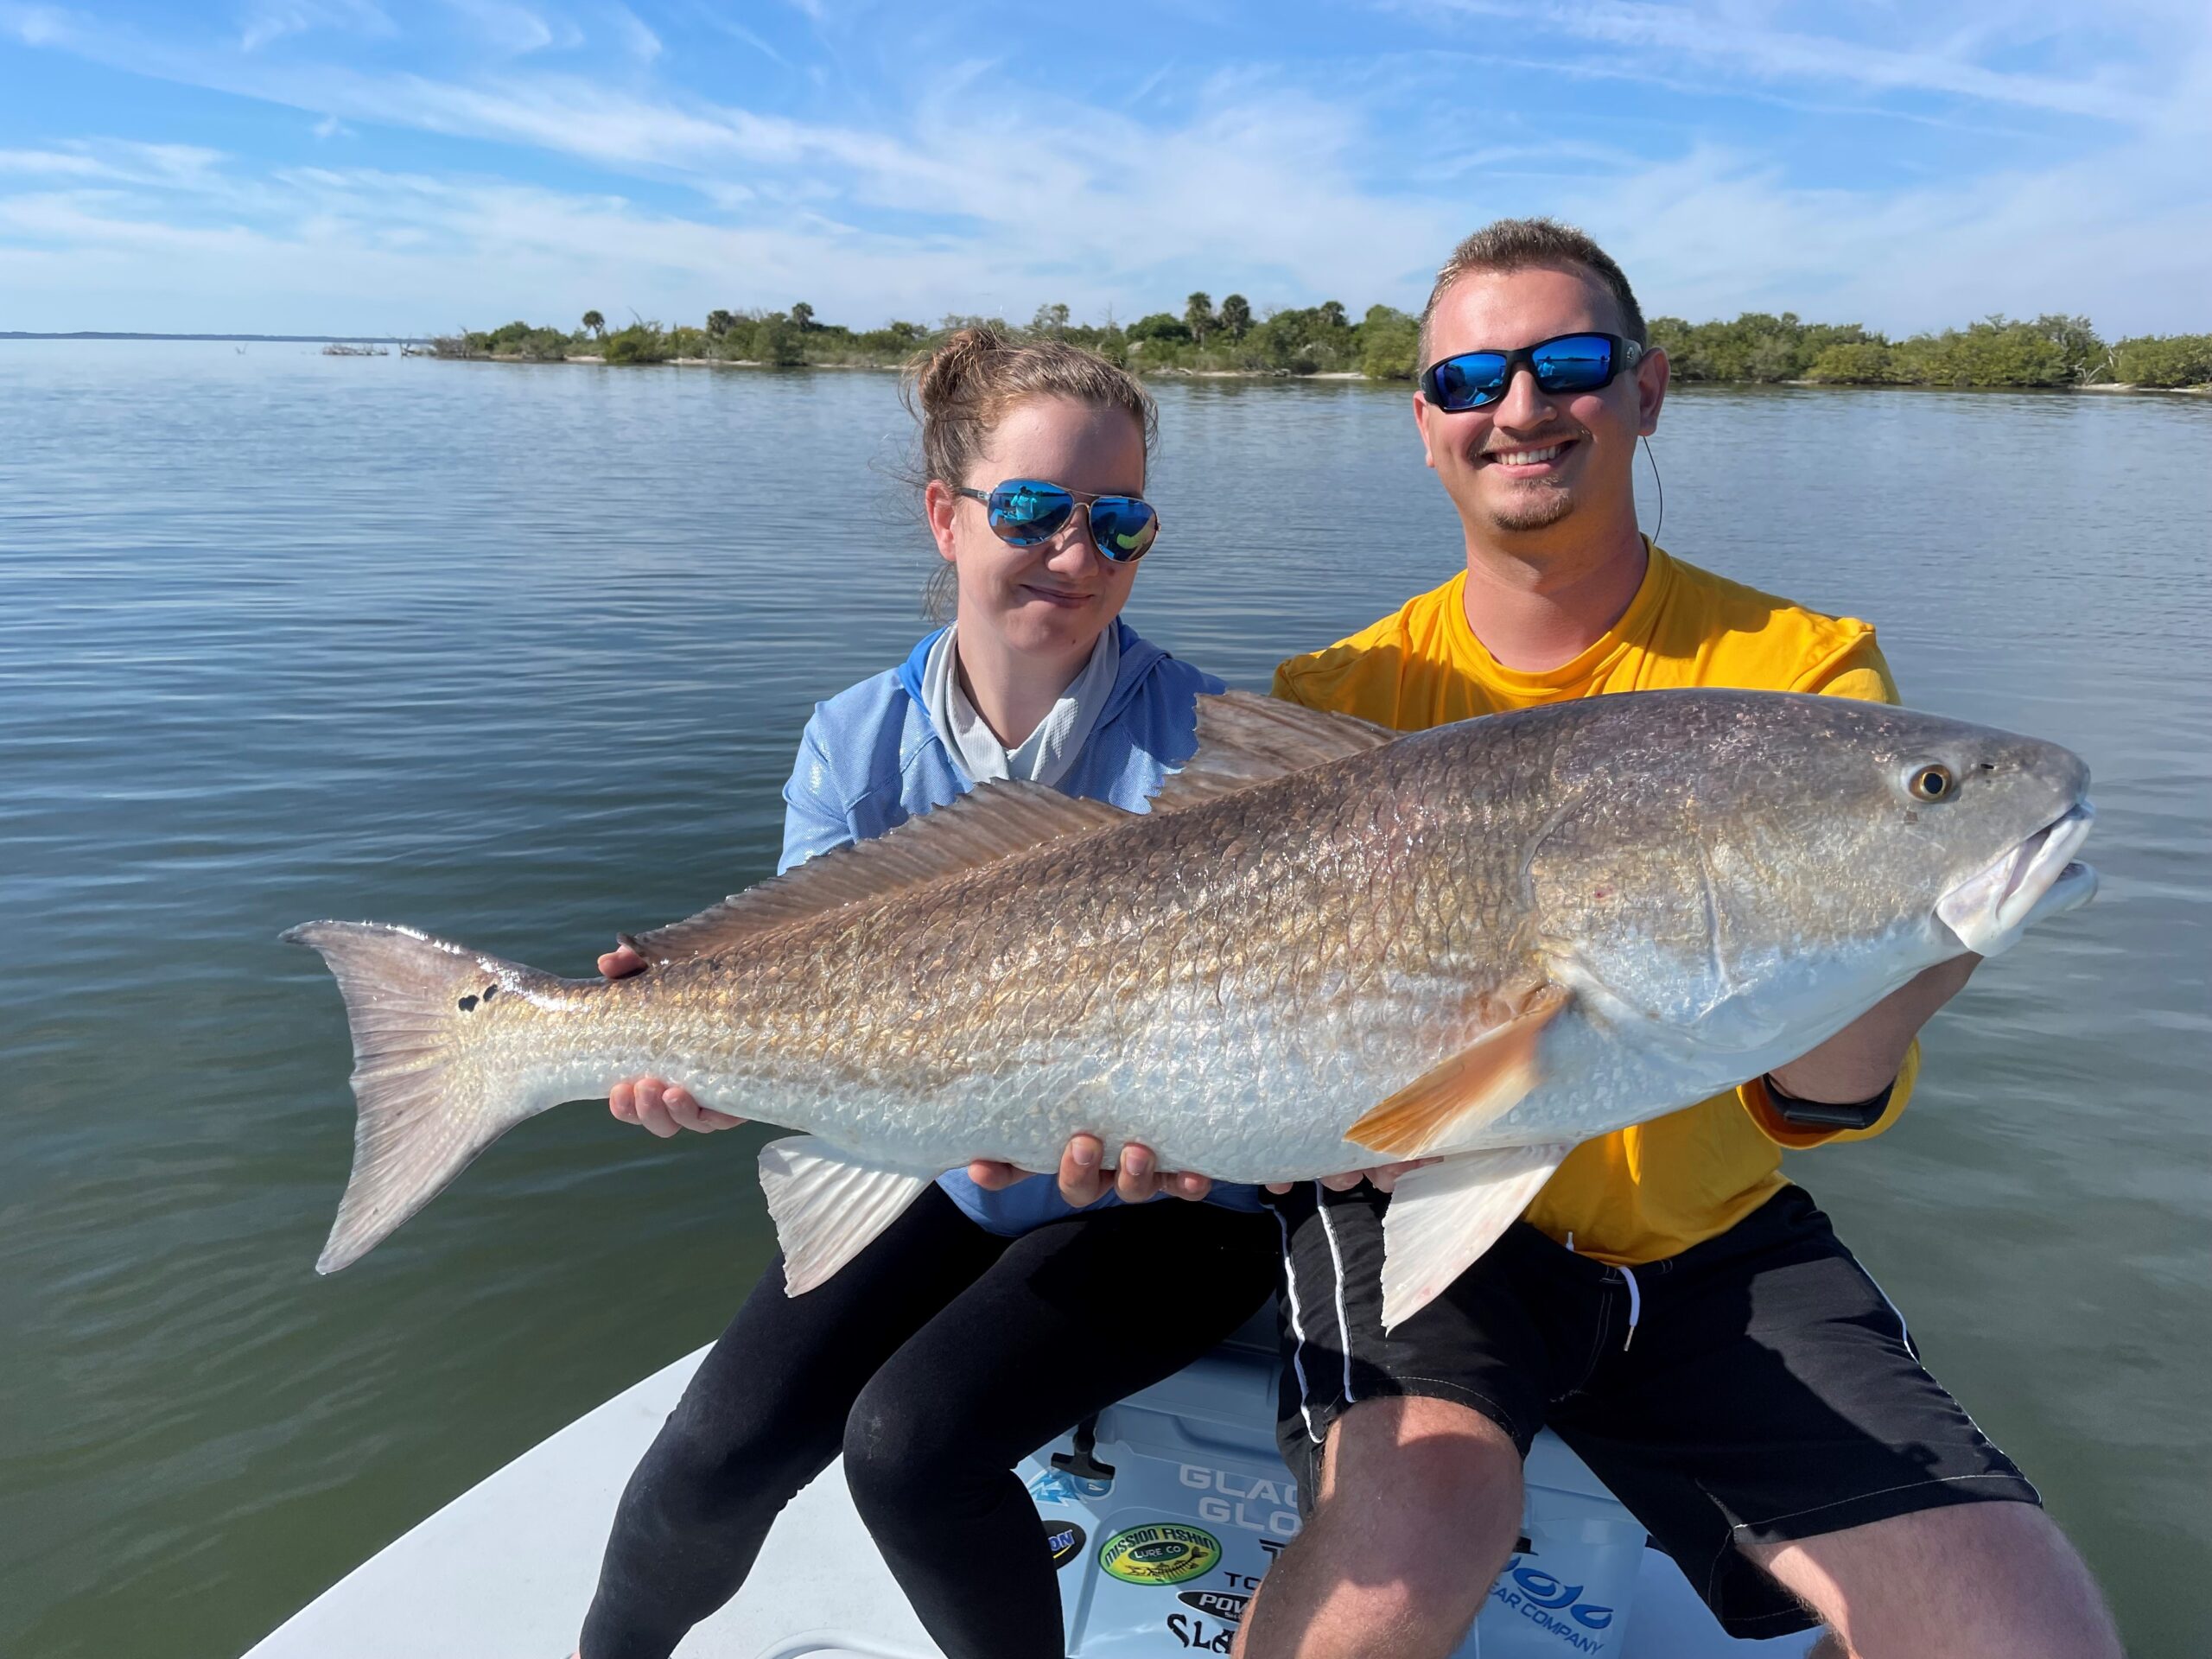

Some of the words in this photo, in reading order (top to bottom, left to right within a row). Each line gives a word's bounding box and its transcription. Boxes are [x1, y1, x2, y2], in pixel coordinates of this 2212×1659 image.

[1105, 1528, 1159, 1567] MISSION
[1134, 1548, 1163, 1559] LURE
[1521, 1602, 1605, 1656] COMPANY
